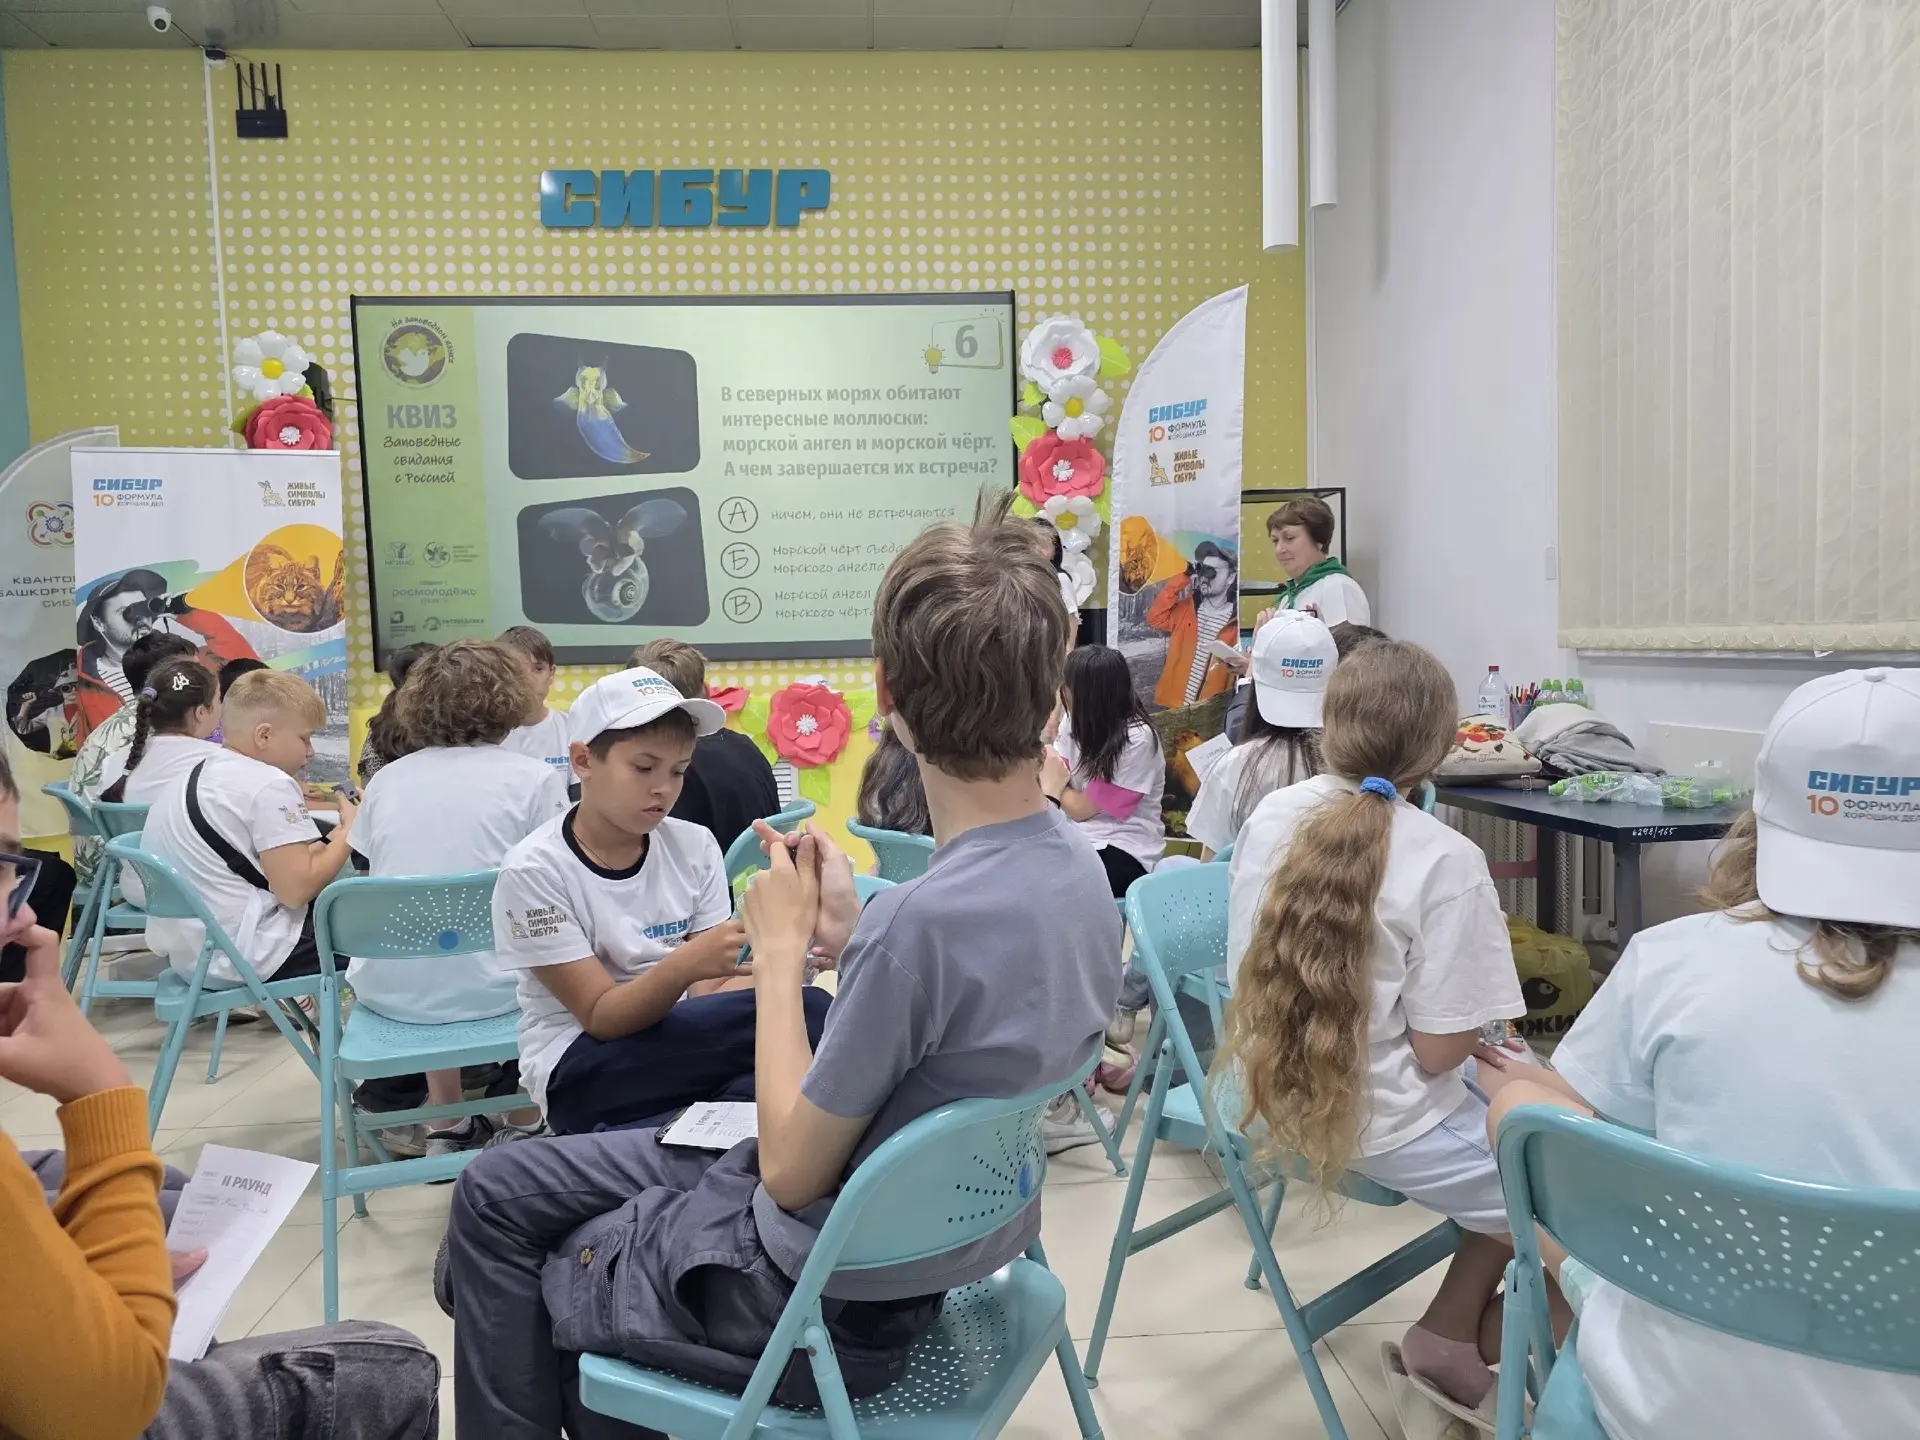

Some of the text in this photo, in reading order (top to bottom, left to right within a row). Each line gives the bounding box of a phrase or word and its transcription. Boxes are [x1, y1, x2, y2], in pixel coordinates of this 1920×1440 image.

[541, 169, 830, 228] СИБУР
[955, 324, 978, 359] 6
[721, 384, 962, 405] В северных морях обитают
[387, 404, 458, 430] КВИЗ
[1148, 399, 1207, 424] СИБУР
[722, 411, 929, 431] интересные моллюски:
[1167, 420, 1207, 433] ФОРМУЛА
[383, 434, 462, 448] Заповедные
[1148, 425, 1165, 443] 10
[723, 432, 996, 455] морской ангел и морской чёрт.
[394, 453, 453, 466] свидания
[724, 457, 998, 480] А чем завершается их встреча?
[93, 478, 163, 491] СИБУР
[395, 471, 456, 484] с Россией
[287, 482, 316, 490] ЖИВЫЕ
[93, 494, 115, 507] 10
[116, 493, 163, 502] ФОРМУЛА
[287, 491, 326, 499] СИМВОЛЫ
[287, 499, 316, 507] СИБУРА
[727, 500, 748, 525] А
[771, 507, 955, 522] ничем, они не встречаются
[773, 543, 827, 558] морской
[831, 543, 861, 559] чёрт
[728, 549, 749, 571] Б
[774, 562, 885, 576] морского ангела
[775, 588, 871, 604] морской ангел
[42, 599, 75, 608] СИБ
[729, 594, 751, 616] В
[776, 607, 834, 620] морского
[1281, 658, 1324, 668] СИБУР
[1281, 669, 1295, 678] 10
[1807, 770, 1920, 796] СИБУР
[1806, 794, 1840, 816] 10
[525, 906, 556, 919] ЖИВЫЕ
[528, 914, 567, 928] СИМВОЛЫ
[530, 926, 559, 938] СИБУРА
[232, 1176, 273, 1198] РАУНД
